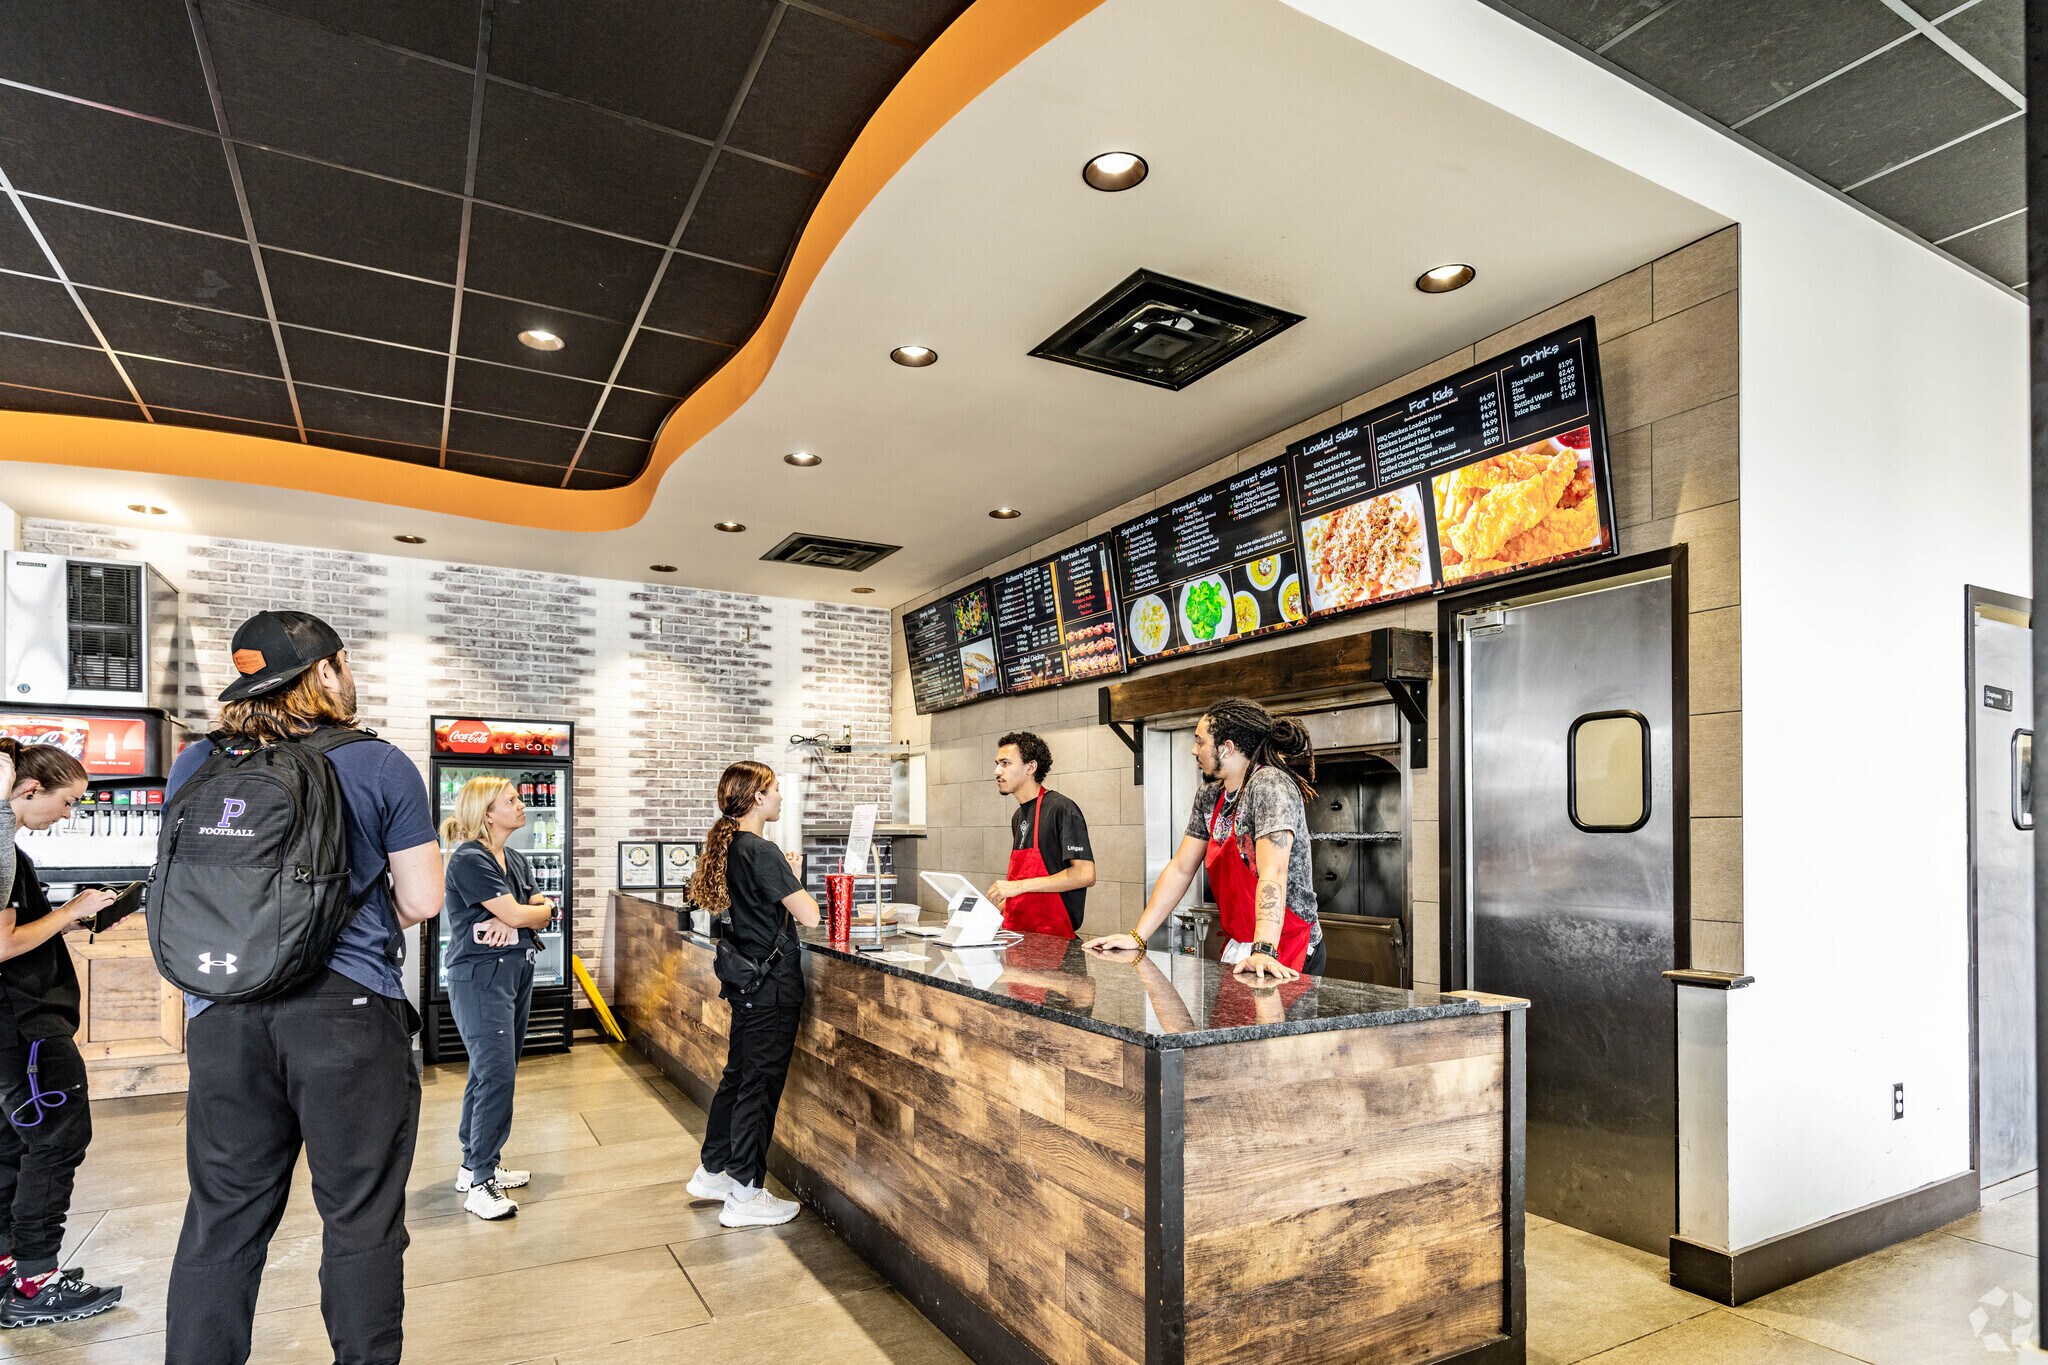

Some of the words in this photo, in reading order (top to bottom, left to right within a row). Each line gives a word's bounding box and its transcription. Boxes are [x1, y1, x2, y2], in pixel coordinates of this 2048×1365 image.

[1521, 345, 1559, 367] Drinks
[1558, 358, 1573, 369] $1.99
[1559, 366, 1575, 377] $2.49
[1560, 374, 1575, 385] $2.99
[1409, 398, 1429, 413] For
[1433, 386, 1453, 403] Kids
[1514, 397, 1534, 410] Bottled
[1534, 391, 1553, 402] Water
[1560, 382, 1576, 392] $1.49
[1515, 408, 1529, 417] Juice
[1530, 403, 1541, 412] Box
[1561, 389, 1576, 400] $1.49
[1388, 427, 1408, 439] Chicken
[1409, 418, 1427, 431] Loaded
[1428, 414, 1442, 423] Fries
[1303, 434, 1333, 456] Loaded
[1336, 428, 1358, 443] Sides
[1378, 439, 1398, 451] Chicken
[1398, 431, 1417, 443] Loaded
[1417, 427, 1430, 436] Fries
[1379, 447, 1398, 459] Chicken
[1399, 439, 1417, 451] Loaded
[1418, 436, 1429, 444] Mac
[1435, 426, 1454, 437] Cheese
[1323, 454, 1339, 465] Loaded
[1339, 451, 1351, 459] Fries
[1379, 455, 1396, 467] Grilled
[1397, 450, 1415, 460] Cheese
[1416, 442, 1432, 453] Panini
[1380, 463, 1397, 475] Grilled
[1398, 457, 1419, 468] Chicken
[1420, 450, 1438, 460] Cheese
[1439, 442, 1456, 453] Panini
[1315, 466, 1331, 477] Loaded
[1345, 456, 1361, 465] Cheese
[1319, 473, 1334, 484] Loaded
[1349, 463, 1365, 473] Cheese
[1391, 468, 1412, 479] Chicken
[1412, 463, 1425, 472] Strip
[1230, 473, 1258, 491] Gourmet
[1260, 466, 1277, 478] Sides
[1312, 485, 1330, 495] Chicken
[1331, 477, 1346, 488] Loaded
[1347, 474, 1358, 482] Fries
[1172, 501, 1196, 515] Premium
[1197, 493, 1213, 505] Sides
[1307, 496, 1325, 506] Chicken
[1325, 488, 1341, 499] Loaded
[1341, 485, 1355, 494] Yellow
[1121, 522, 1144, 538] Signature
[1145, 516, 1158, 527] Sides
[449, 730, 490, 744] Coca-Cola
[217, 798, 246, 827] P
[198, 827, 255, 836] FOOTBALL
